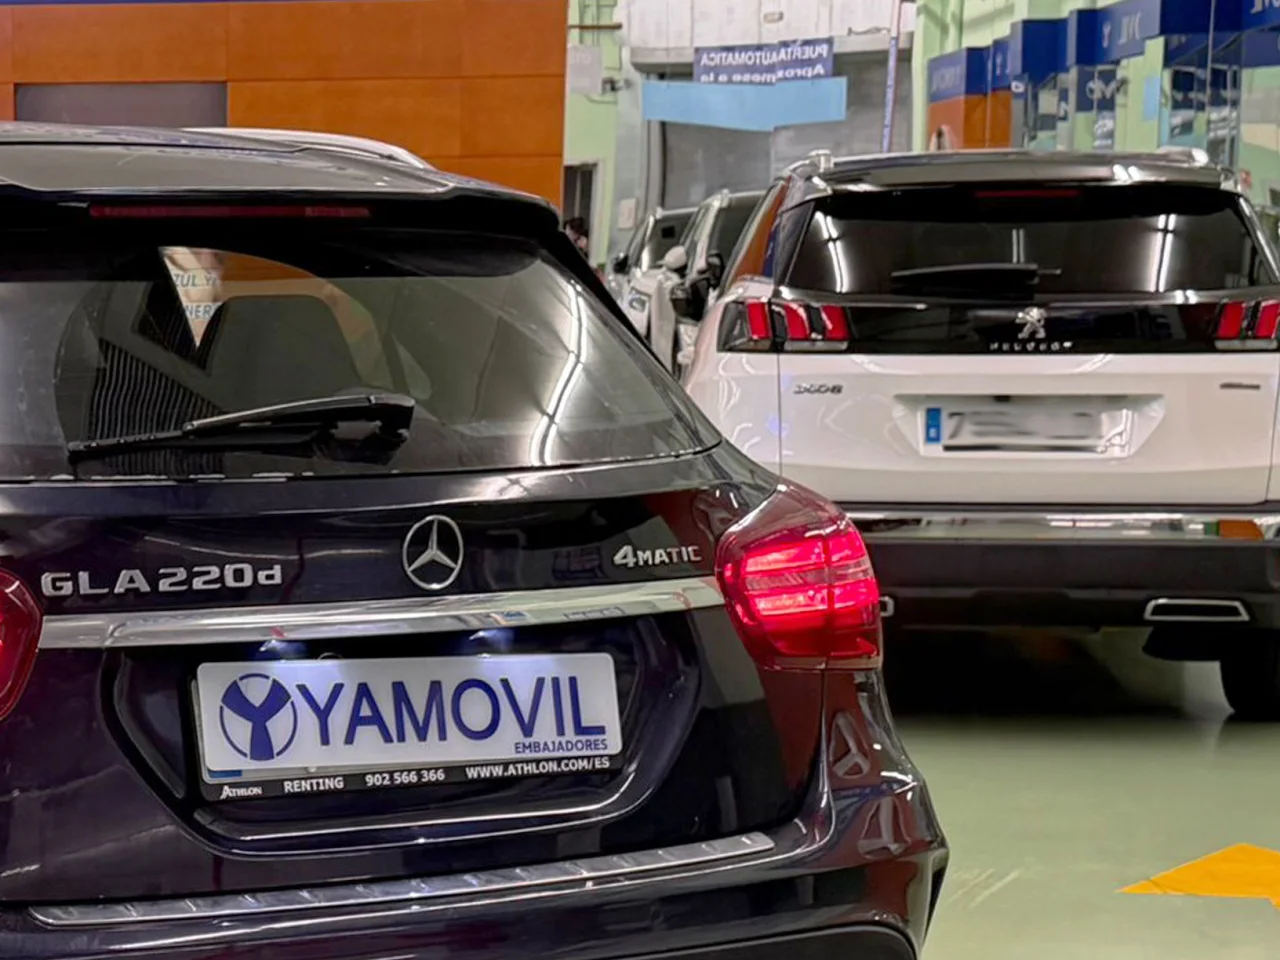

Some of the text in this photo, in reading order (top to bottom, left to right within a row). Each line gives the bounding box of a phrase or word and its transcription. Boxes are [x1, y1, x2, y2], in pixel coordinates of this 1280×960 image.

[613, 545, 702, 567] 4MATIC
[295, 676, 606, 747] YAMOVIL
[514, 738, 609, 755] EMBAJADORES
[283, 777, 344, 793] RENTING
[365, 772, 391, 787] 902
[393, 770, 419, 785] 566
[421, 769, 446, 783] 366
[465, 756, 610, 779] WWW.ATHLON.COM/ES
